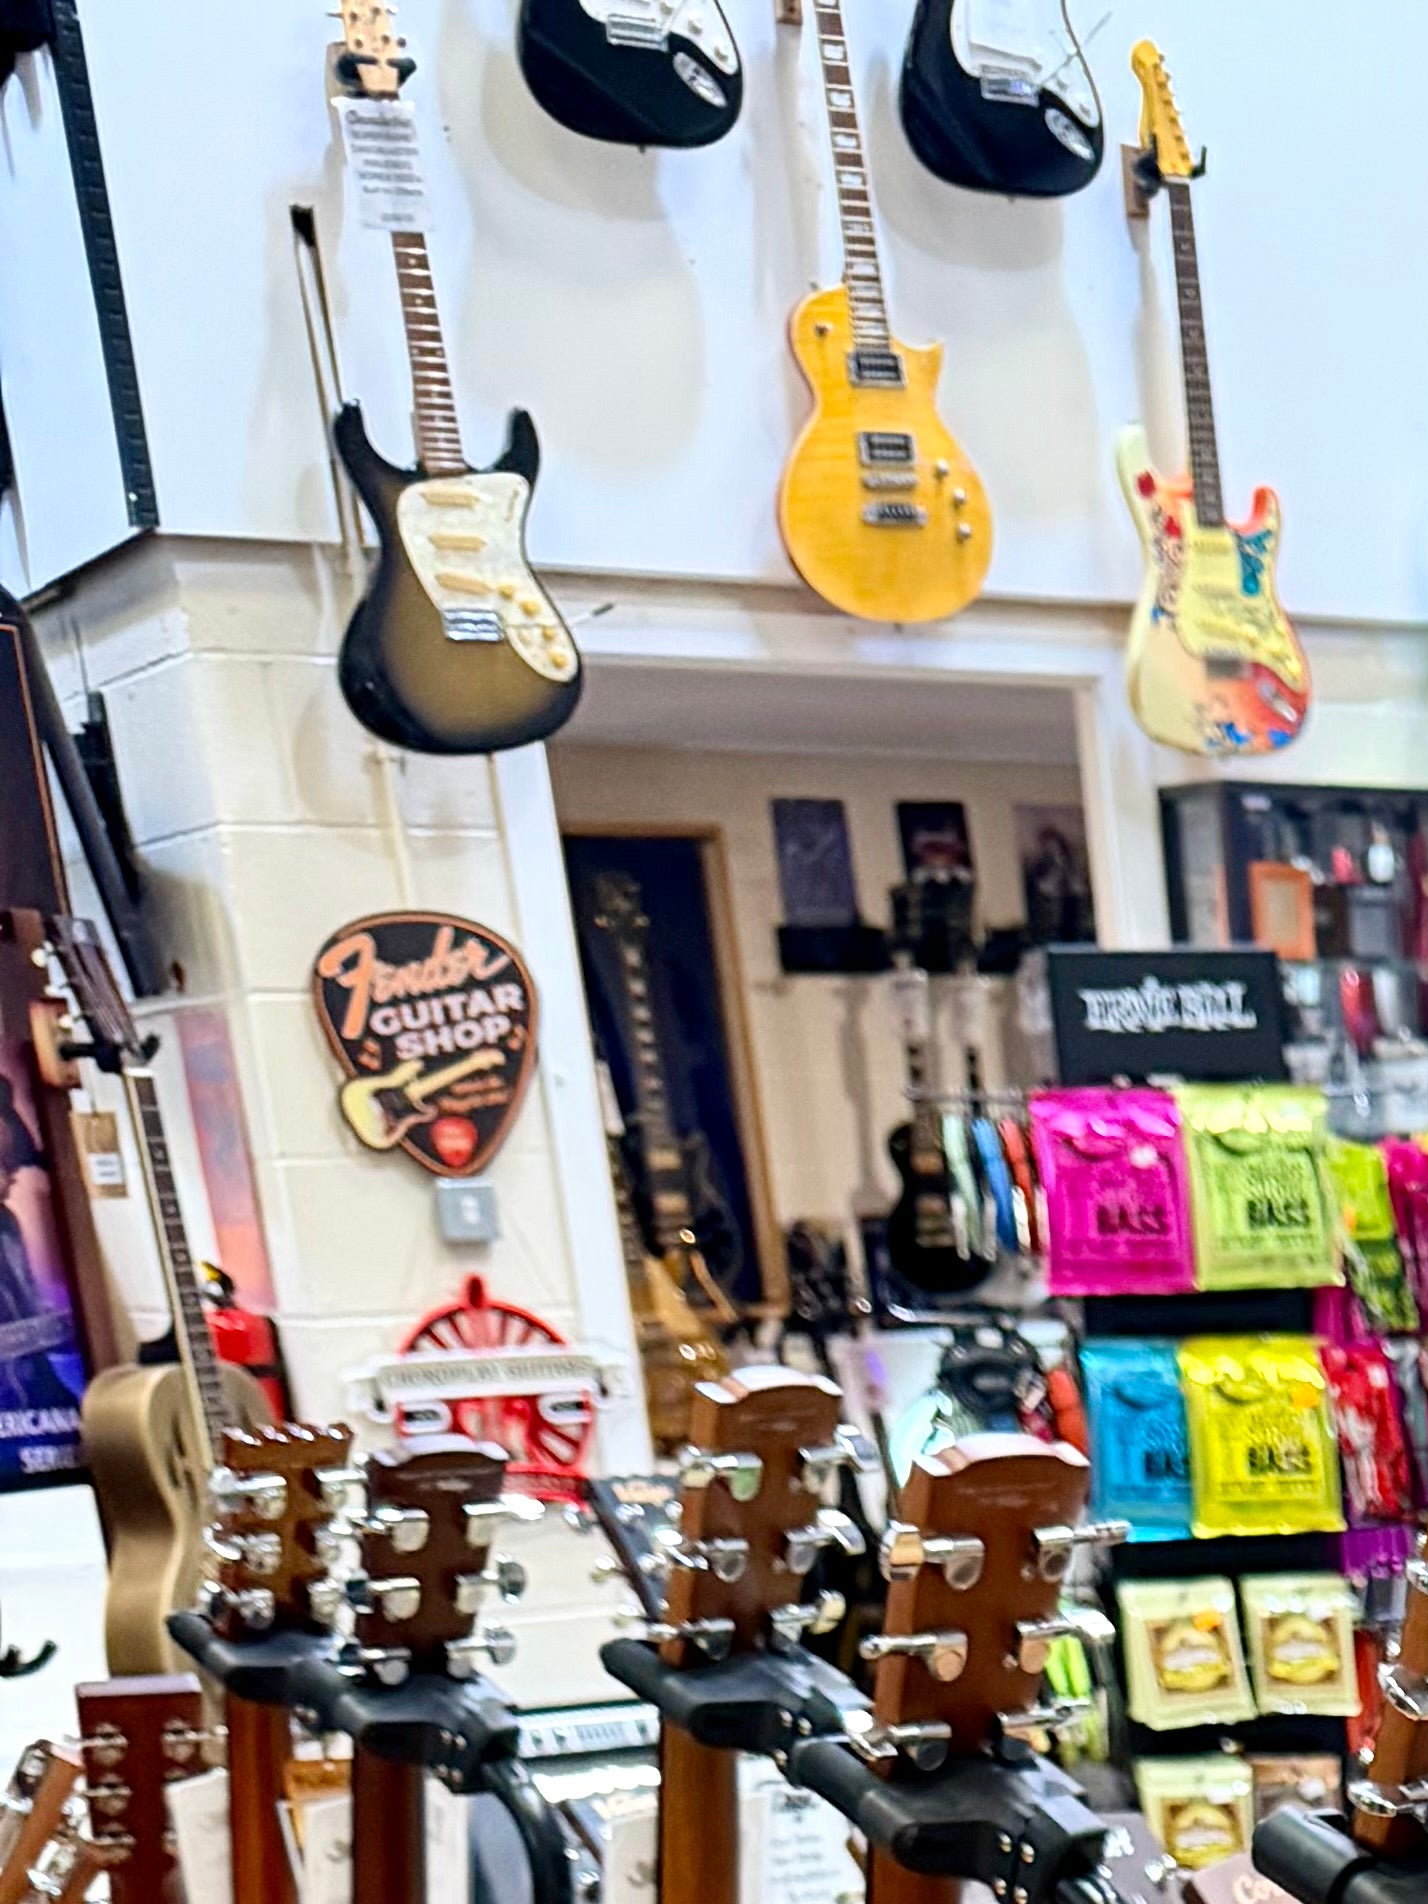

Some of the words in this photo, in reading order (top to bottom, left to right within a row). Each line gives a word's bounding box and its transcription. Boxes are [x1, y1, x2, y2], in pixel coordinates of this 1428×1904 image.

[318, 925, 511, 1040] Fender
[369, 983, 525, 1037] GUITAR
[395, 1015, 511, 1061] SHOP
